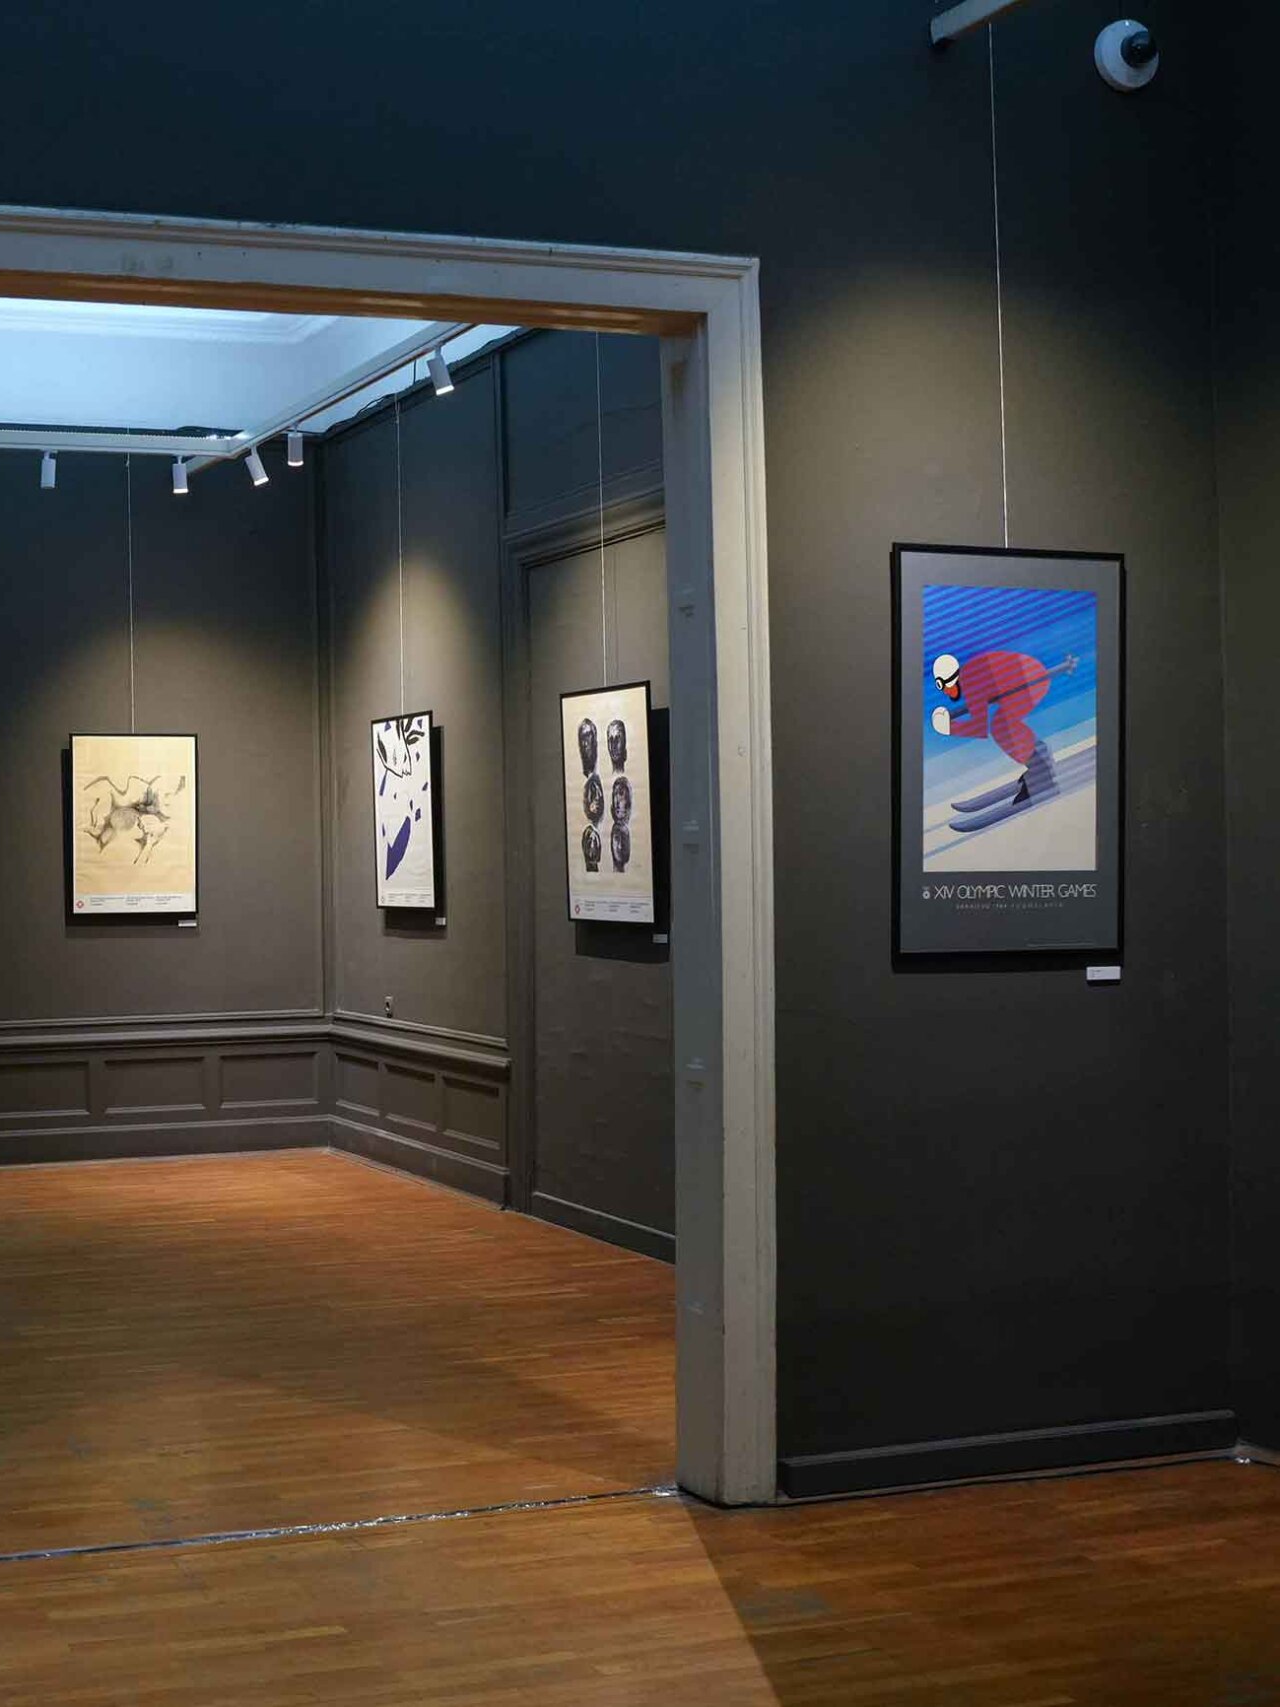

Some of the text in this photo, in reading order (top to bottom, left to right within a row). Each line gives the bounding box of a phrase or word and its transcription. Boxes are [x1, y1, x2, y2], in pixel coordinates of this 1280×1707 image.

[934, 883, 1097, 899] XIV OLYMPIC WINTER GAMES
